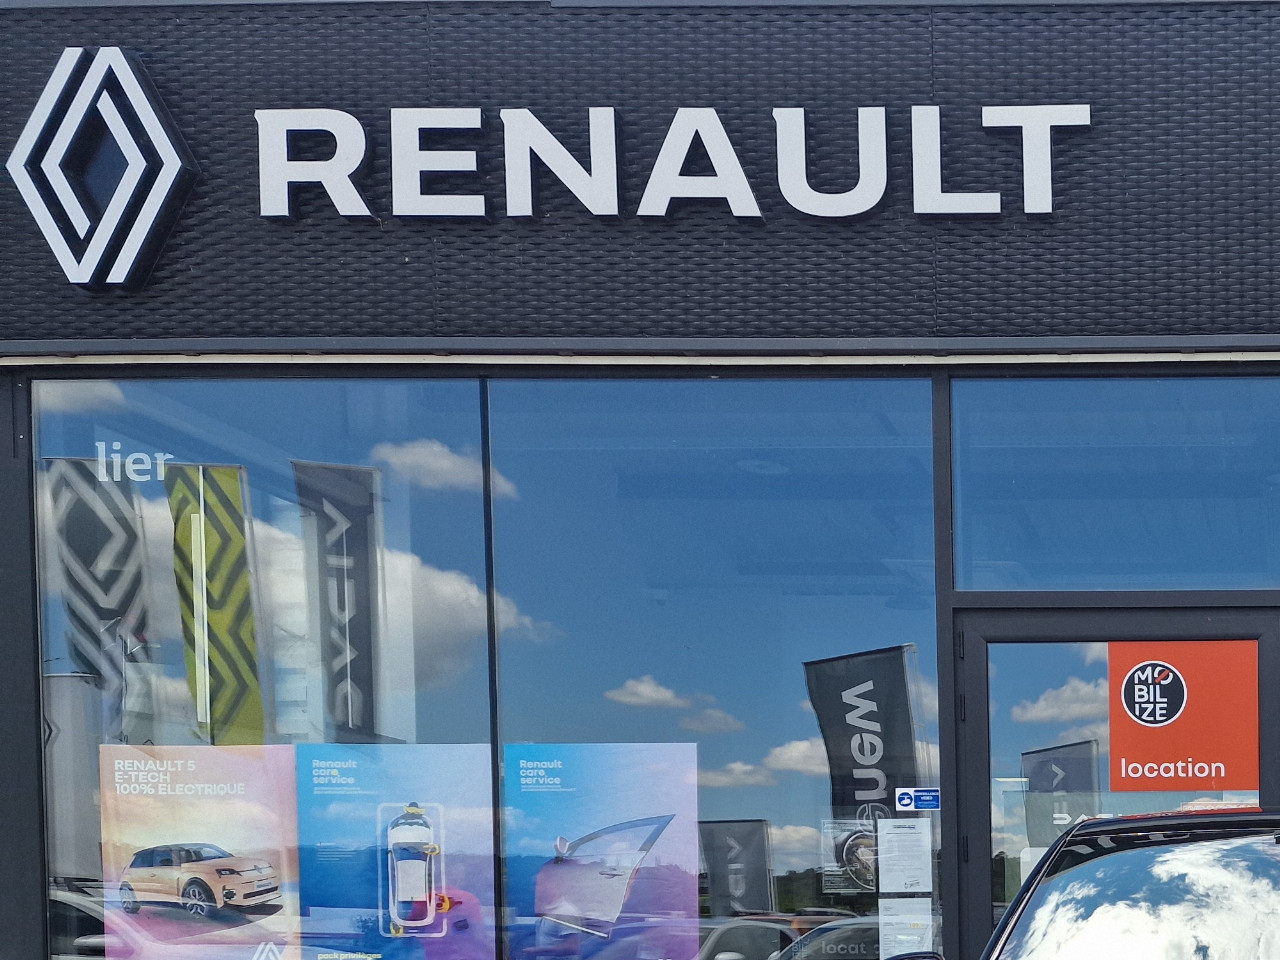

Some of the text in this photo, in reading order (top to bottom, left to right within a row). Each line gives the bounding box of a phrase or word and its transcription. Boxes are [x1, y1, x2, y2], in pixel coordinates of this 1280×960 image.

[255, 104, 1090, 217] RENAULT
[114, 759, 196, 771] RENAULT 5
[312, 759, 358, 768] Renault
[519, 759, 563, 768] Renault
[1121, 757, 1226, 779] location
[312, 768, 339, 776] care
[519, 768, 546, 777] care
[114, 771, 171, 783] E-TECH
[312, 775, 355, 784] service
[520, 776, 561, 784] service
[116, 783, 246, 796] 100% ELECTRIQUE
